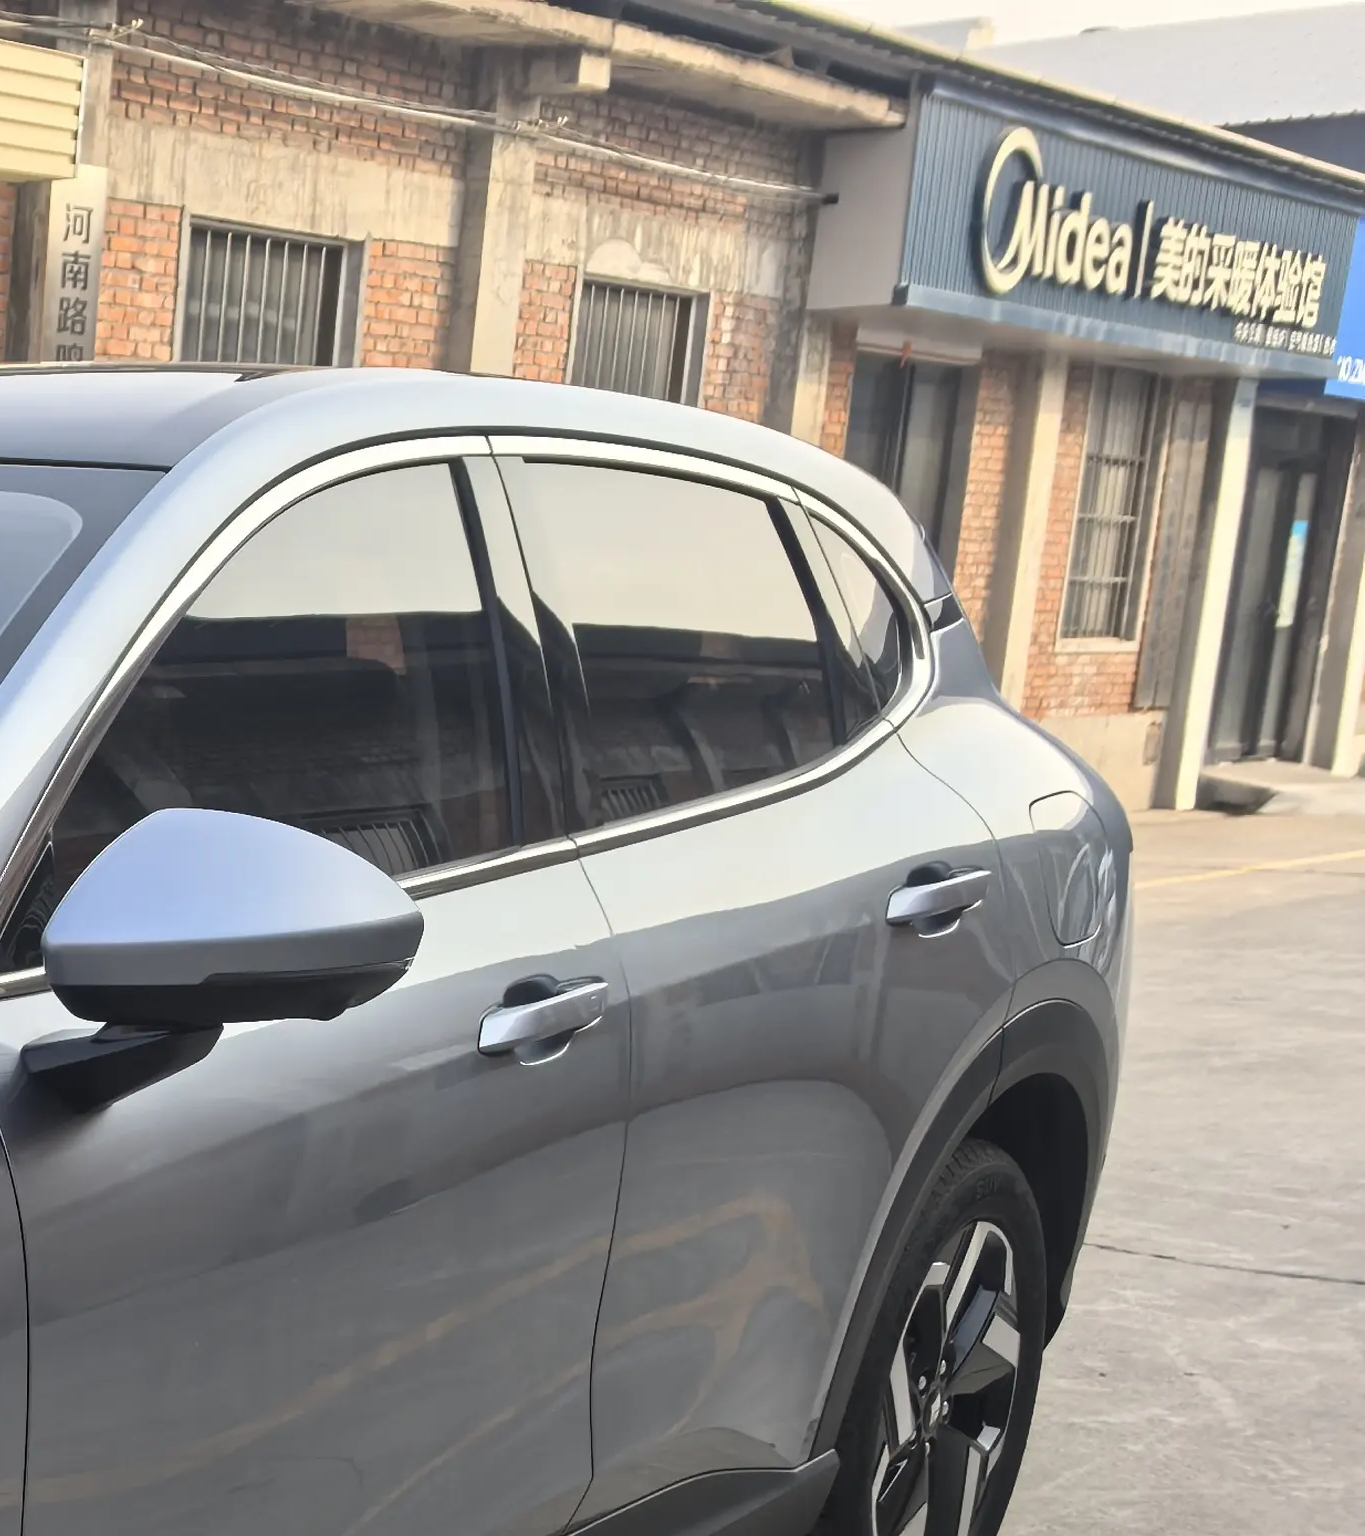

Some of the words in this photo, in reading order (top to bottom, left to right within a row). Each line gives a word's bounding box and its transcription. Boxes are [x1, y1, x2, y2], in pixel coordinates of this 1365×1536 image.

[982, 126, 1133, 294] Midea
[1150, 216, 1326, 328] 美的采暖体验馆
